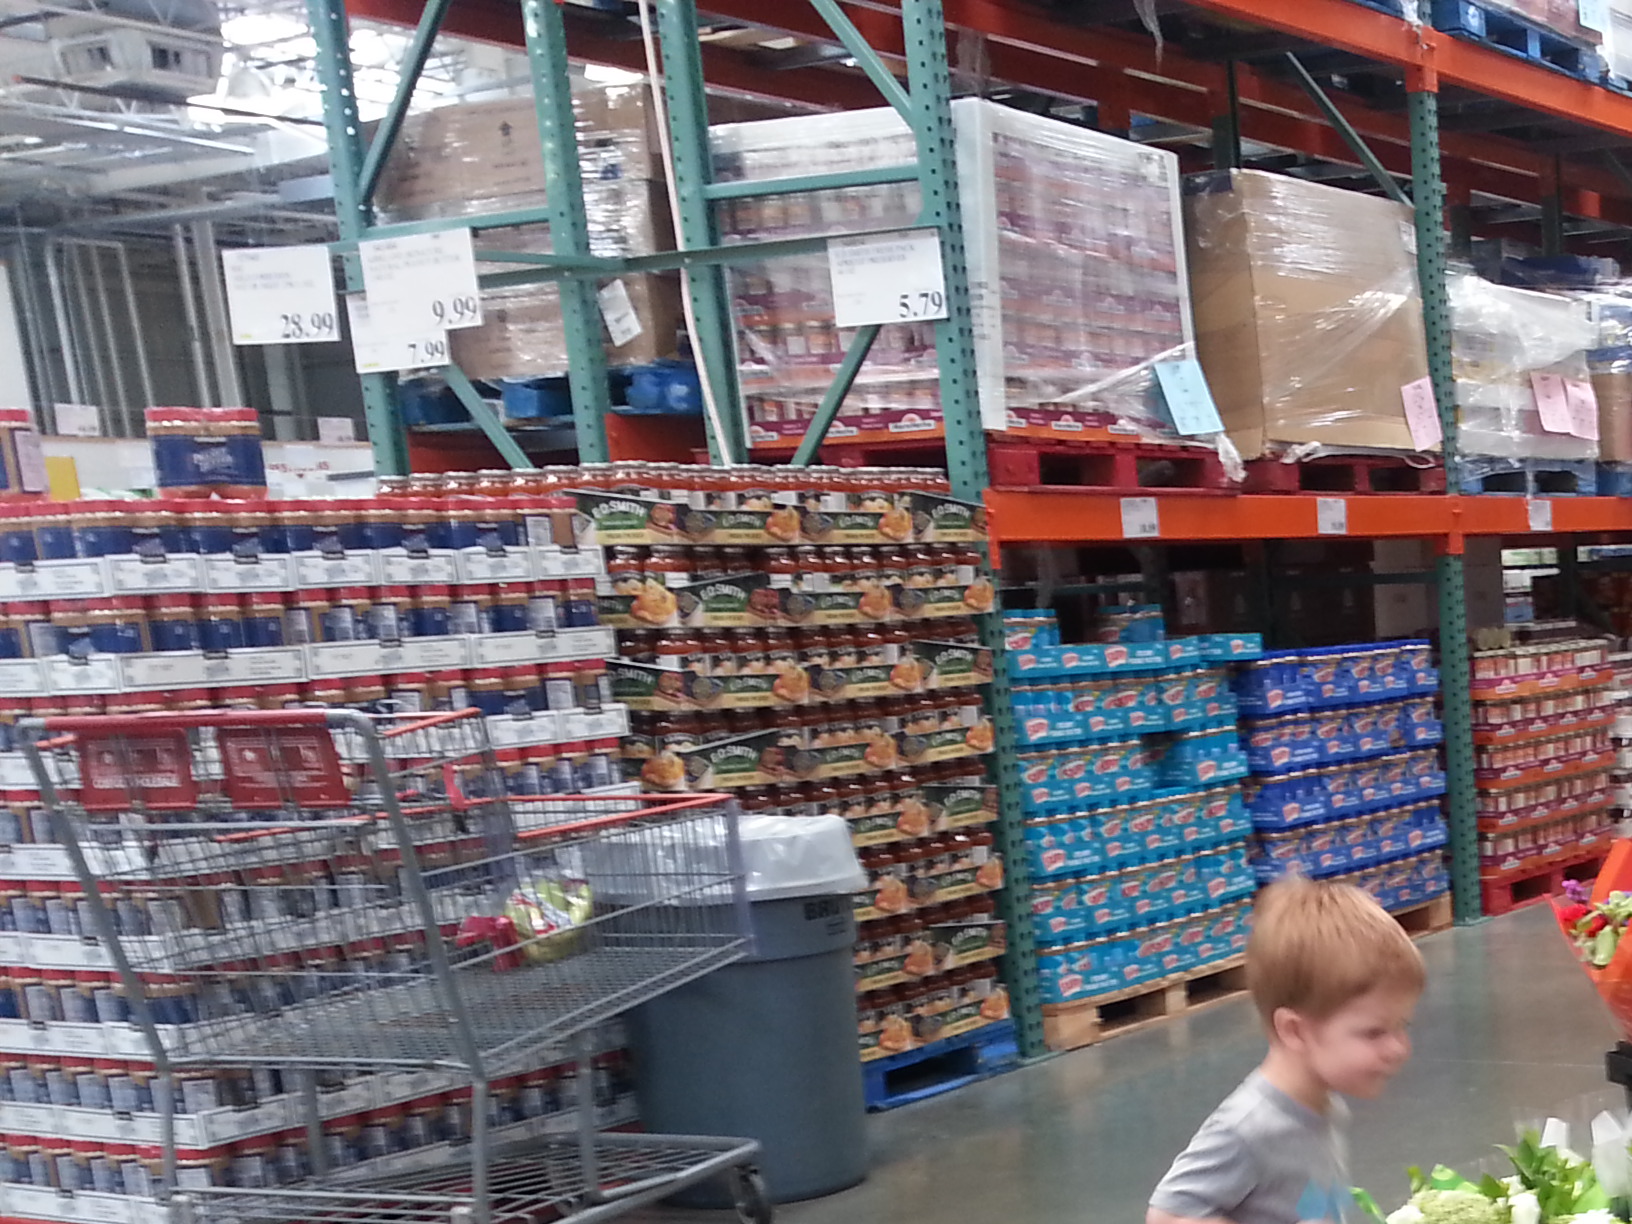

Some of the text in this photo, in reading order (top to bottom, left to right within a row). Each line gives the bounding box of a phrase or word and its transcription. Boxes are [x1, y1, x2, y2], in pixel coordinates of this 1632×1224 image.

[432, 296, 478, 325] 9.99
[899, 291, 943, 318] 5.79
[280, 312, 334, 339] 28.99
[407, 340, 446, 364] 7.99
